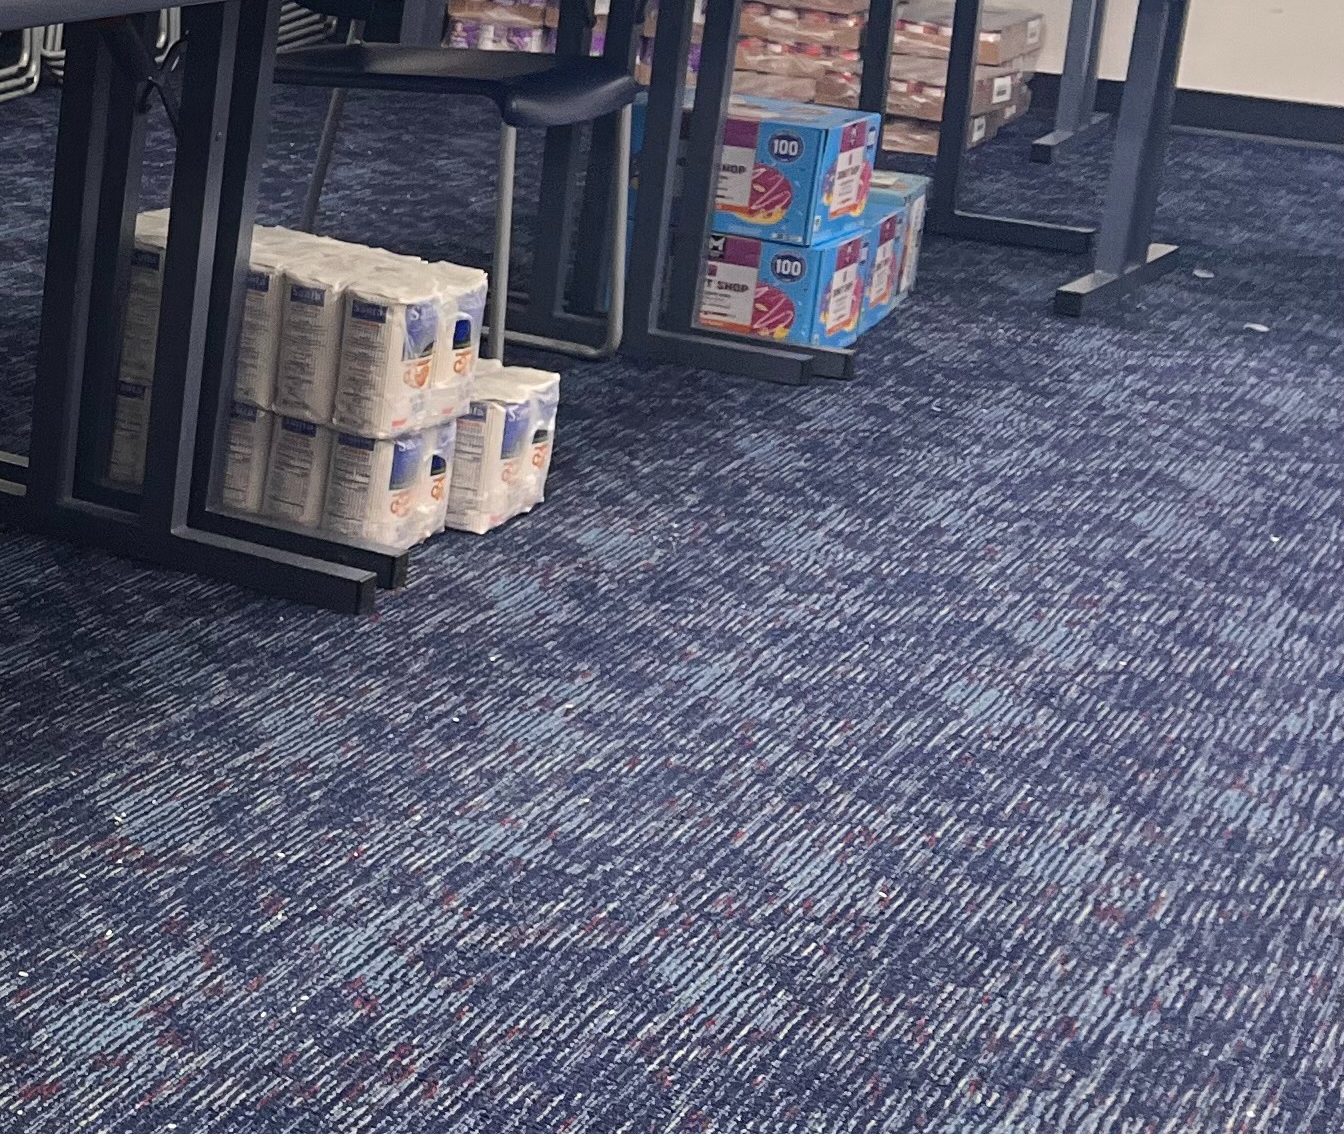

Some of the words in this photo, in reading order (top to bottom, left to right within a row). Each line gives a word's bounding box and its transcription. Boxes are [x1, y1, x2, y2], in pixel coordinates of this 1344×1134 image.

[773, 138, 798, 155] 100
[776, 259, 801, 276] 100
[717, 279, 749, 293] SHOP
